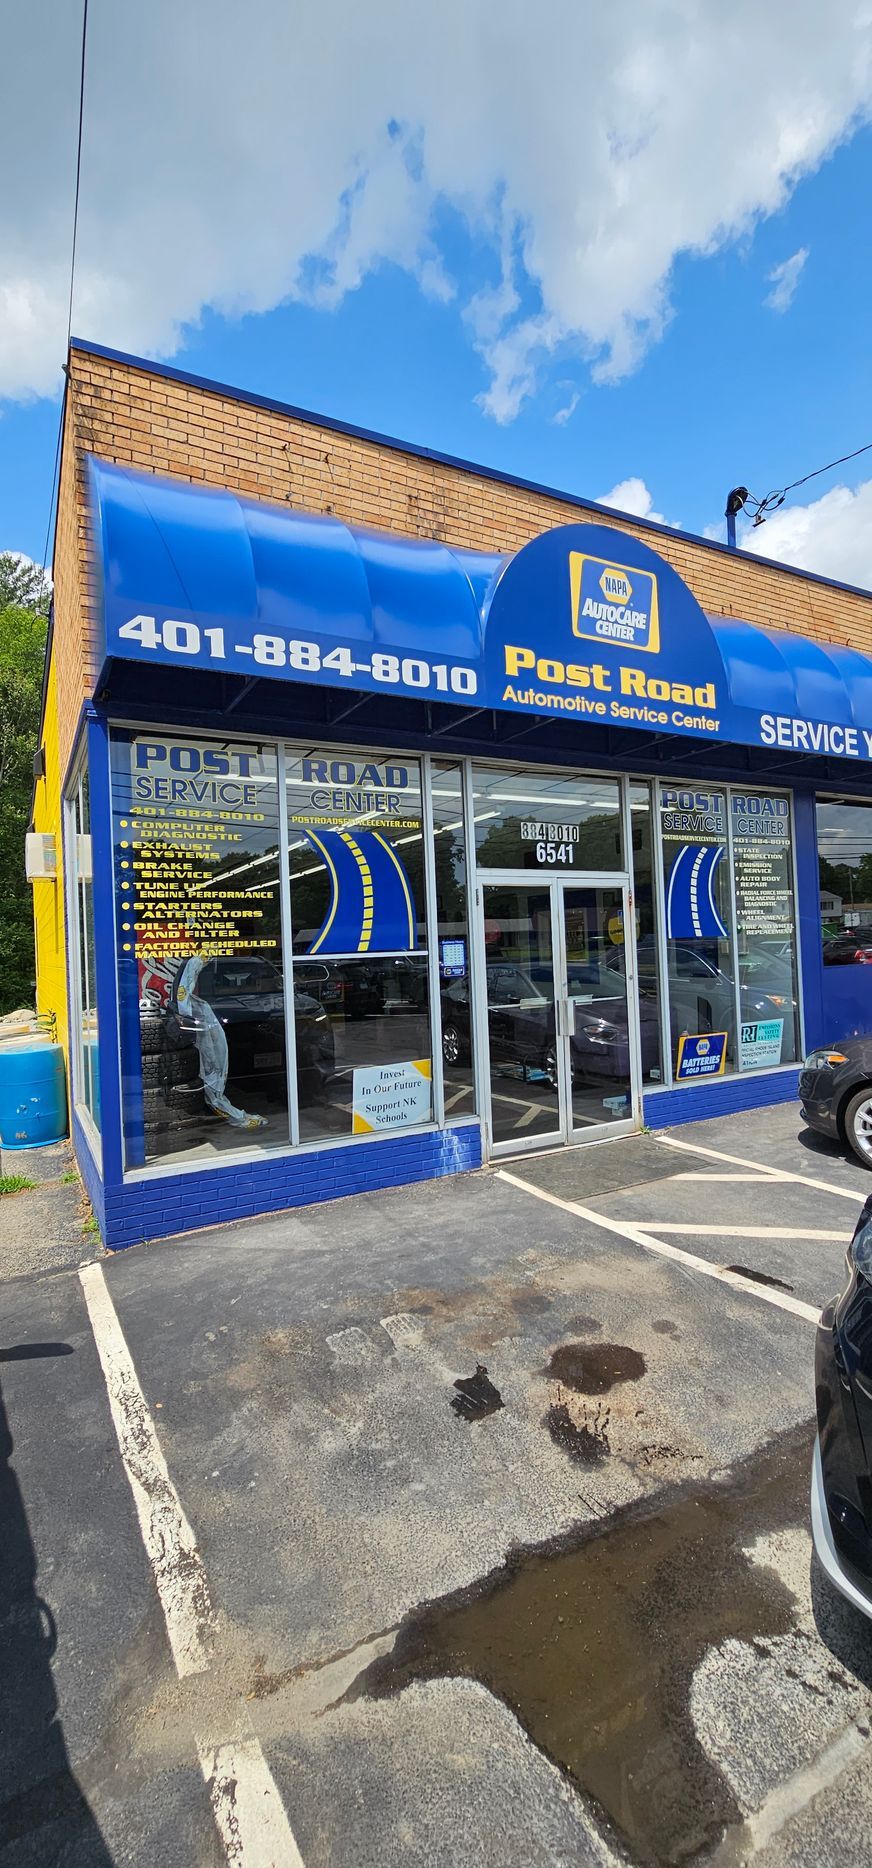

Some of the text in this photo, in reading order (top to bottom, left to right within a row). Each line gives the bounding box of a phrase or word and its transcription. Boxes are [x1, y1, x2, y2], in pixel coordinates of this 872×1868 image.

[604, 576, 628, 597] NAPA
[595, 620, 635, 641] CENTER
[118, 614, 478, 695] 401-884-8010
[504, 644, 716, 709] Post Road
[502, 685, 720, 732] Automotive Service Center
[760, 714, 859, 756] SERVICE
[134, 741, 409, 789] POST ROAD
[134, 775, 401, 814] SERVICE CENTER
[661, 789, 789, 818] POST ROAD
[129, 806, 265, 821] 401-884-8010
[131, 821, 226, 832] COMPUTER
[664, 812, 785, 836] SERVICE CENTER
[140, 830, 243, 841] DIAGNOSTIC
[733, 837, 791, 846] 401-884-8010
[132, 841, 213, 851] EXHAUST
[140, 851, 221, 860] SYSTEMS
[536, 842, 574, 864] 6541
[132, 862, 193, 870] BRAKE
[141, 871, 213, 879] SERVICE
[133, 882, 207, 890] TUNE UP
[139, 891, 274, 899] ENGINE PERFORMANCE
[133, 902, 223, 910] STARTERS
[142, 910, 263, 919] ALTERNATORS
[133, 921, 236, 931] OIL CHANGE
[142, 929, 240, 939] AND FILTER
[134, 939, 277, 951] FACTORY SCHEDULED
[134, 948, 234, 959] MAINTENANCE
[682, 1054, 721, 1069] BATTERIES
[380, 1069, 405, 1080] Invest
[685, 1066, 700, 1075] SOLD
[361, 1080, 422, 1096] In Our Future
[365, 1096, 417, 1114] Support NK
[375, 1111, 408, 1125] Schools
